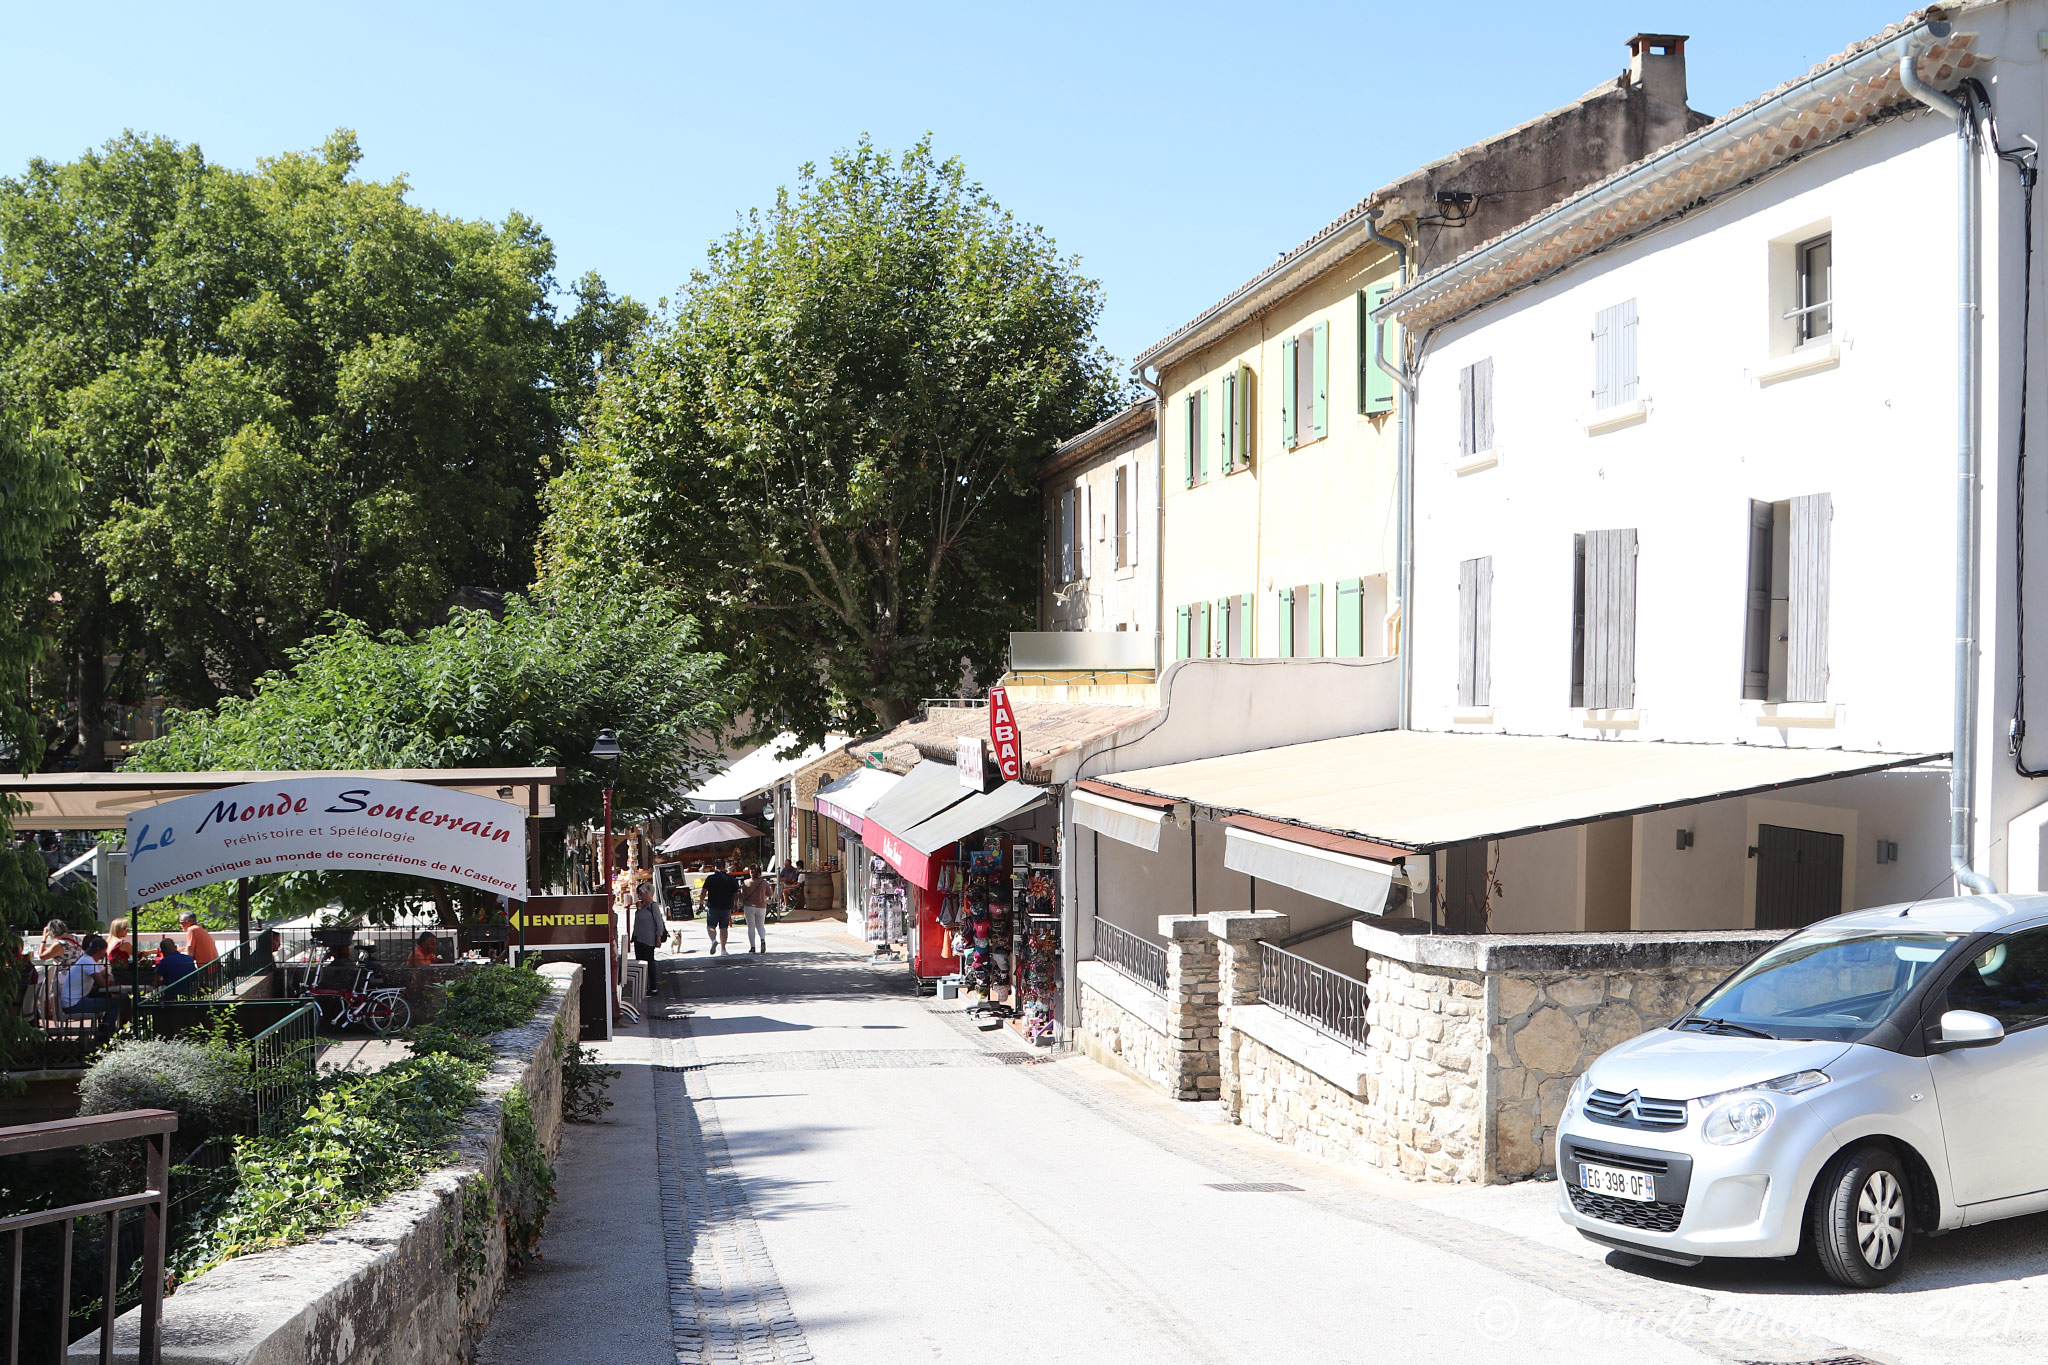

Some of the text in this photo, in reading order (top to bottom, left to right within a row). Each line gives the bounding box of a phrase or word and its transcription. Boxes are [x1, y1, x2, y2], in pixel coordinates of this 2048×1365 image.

[992, 690, 1017, 776] TABAC
[131, 789, 511, 863] Le Monde Souterrain
[224, 825, 416, 848] Préhistoire et Spéléologie
[137, 850, 518, 898] Collection unique au monde de concrétions de N.Casteret
[532, 913, 595, 927] ENTREE
